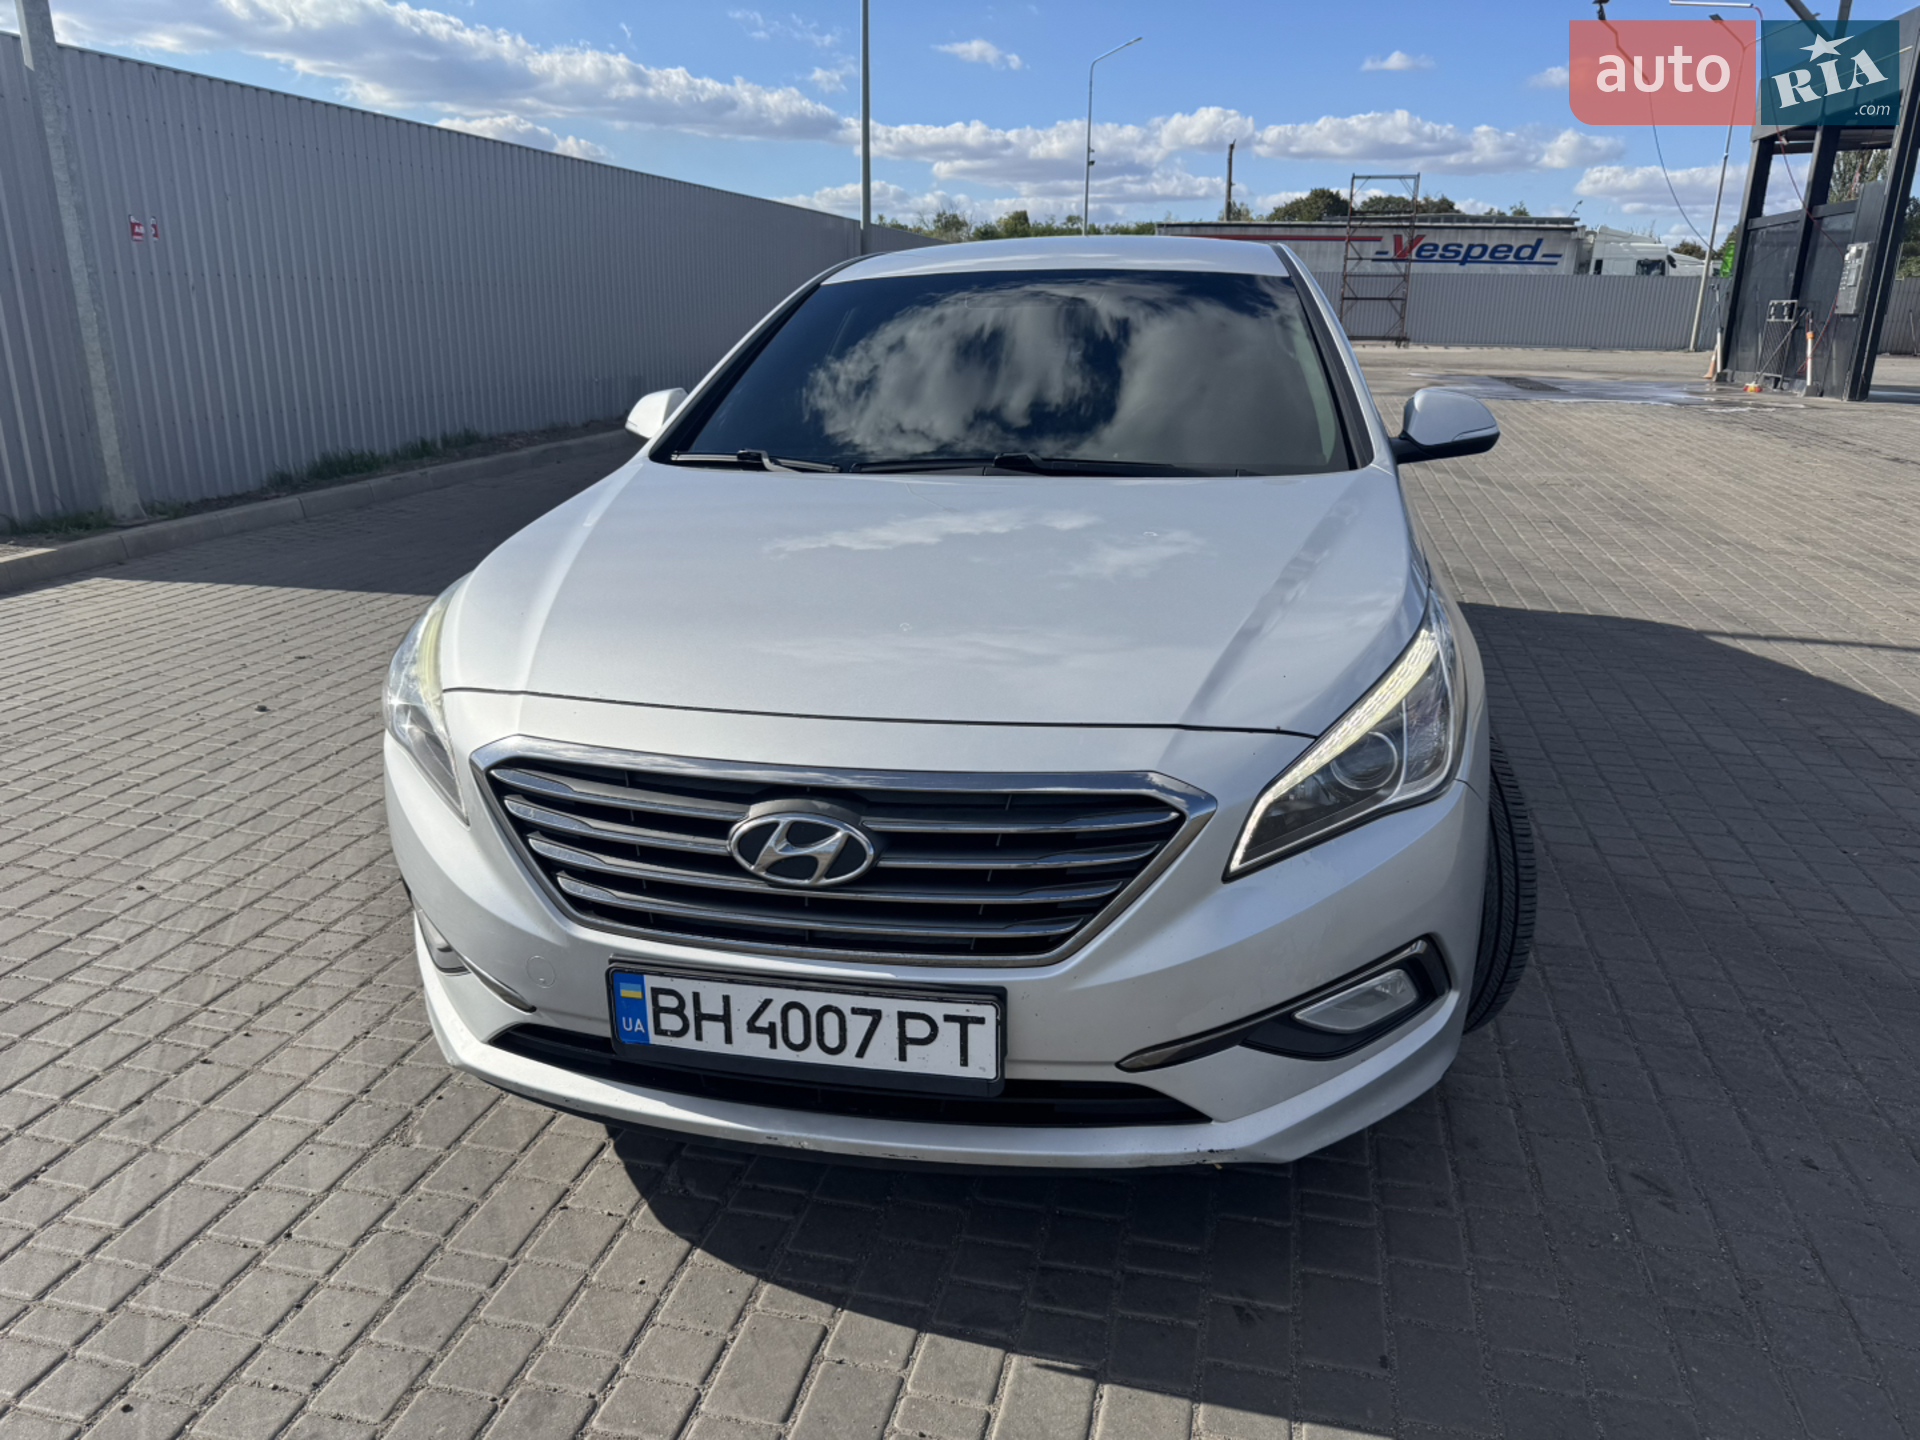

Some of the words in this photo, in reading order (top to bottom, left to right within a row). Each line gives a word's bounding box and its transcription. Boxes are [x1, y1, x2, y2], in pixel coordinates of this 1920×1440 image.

[1393, 234, 1544, 266] Vesped
[622, 1016, 645, 1034] UA
[650, 986, 733, 1045] BH
[746, 998, 882, 1059] 4007
[897, 1010, 986, 1068] PT
